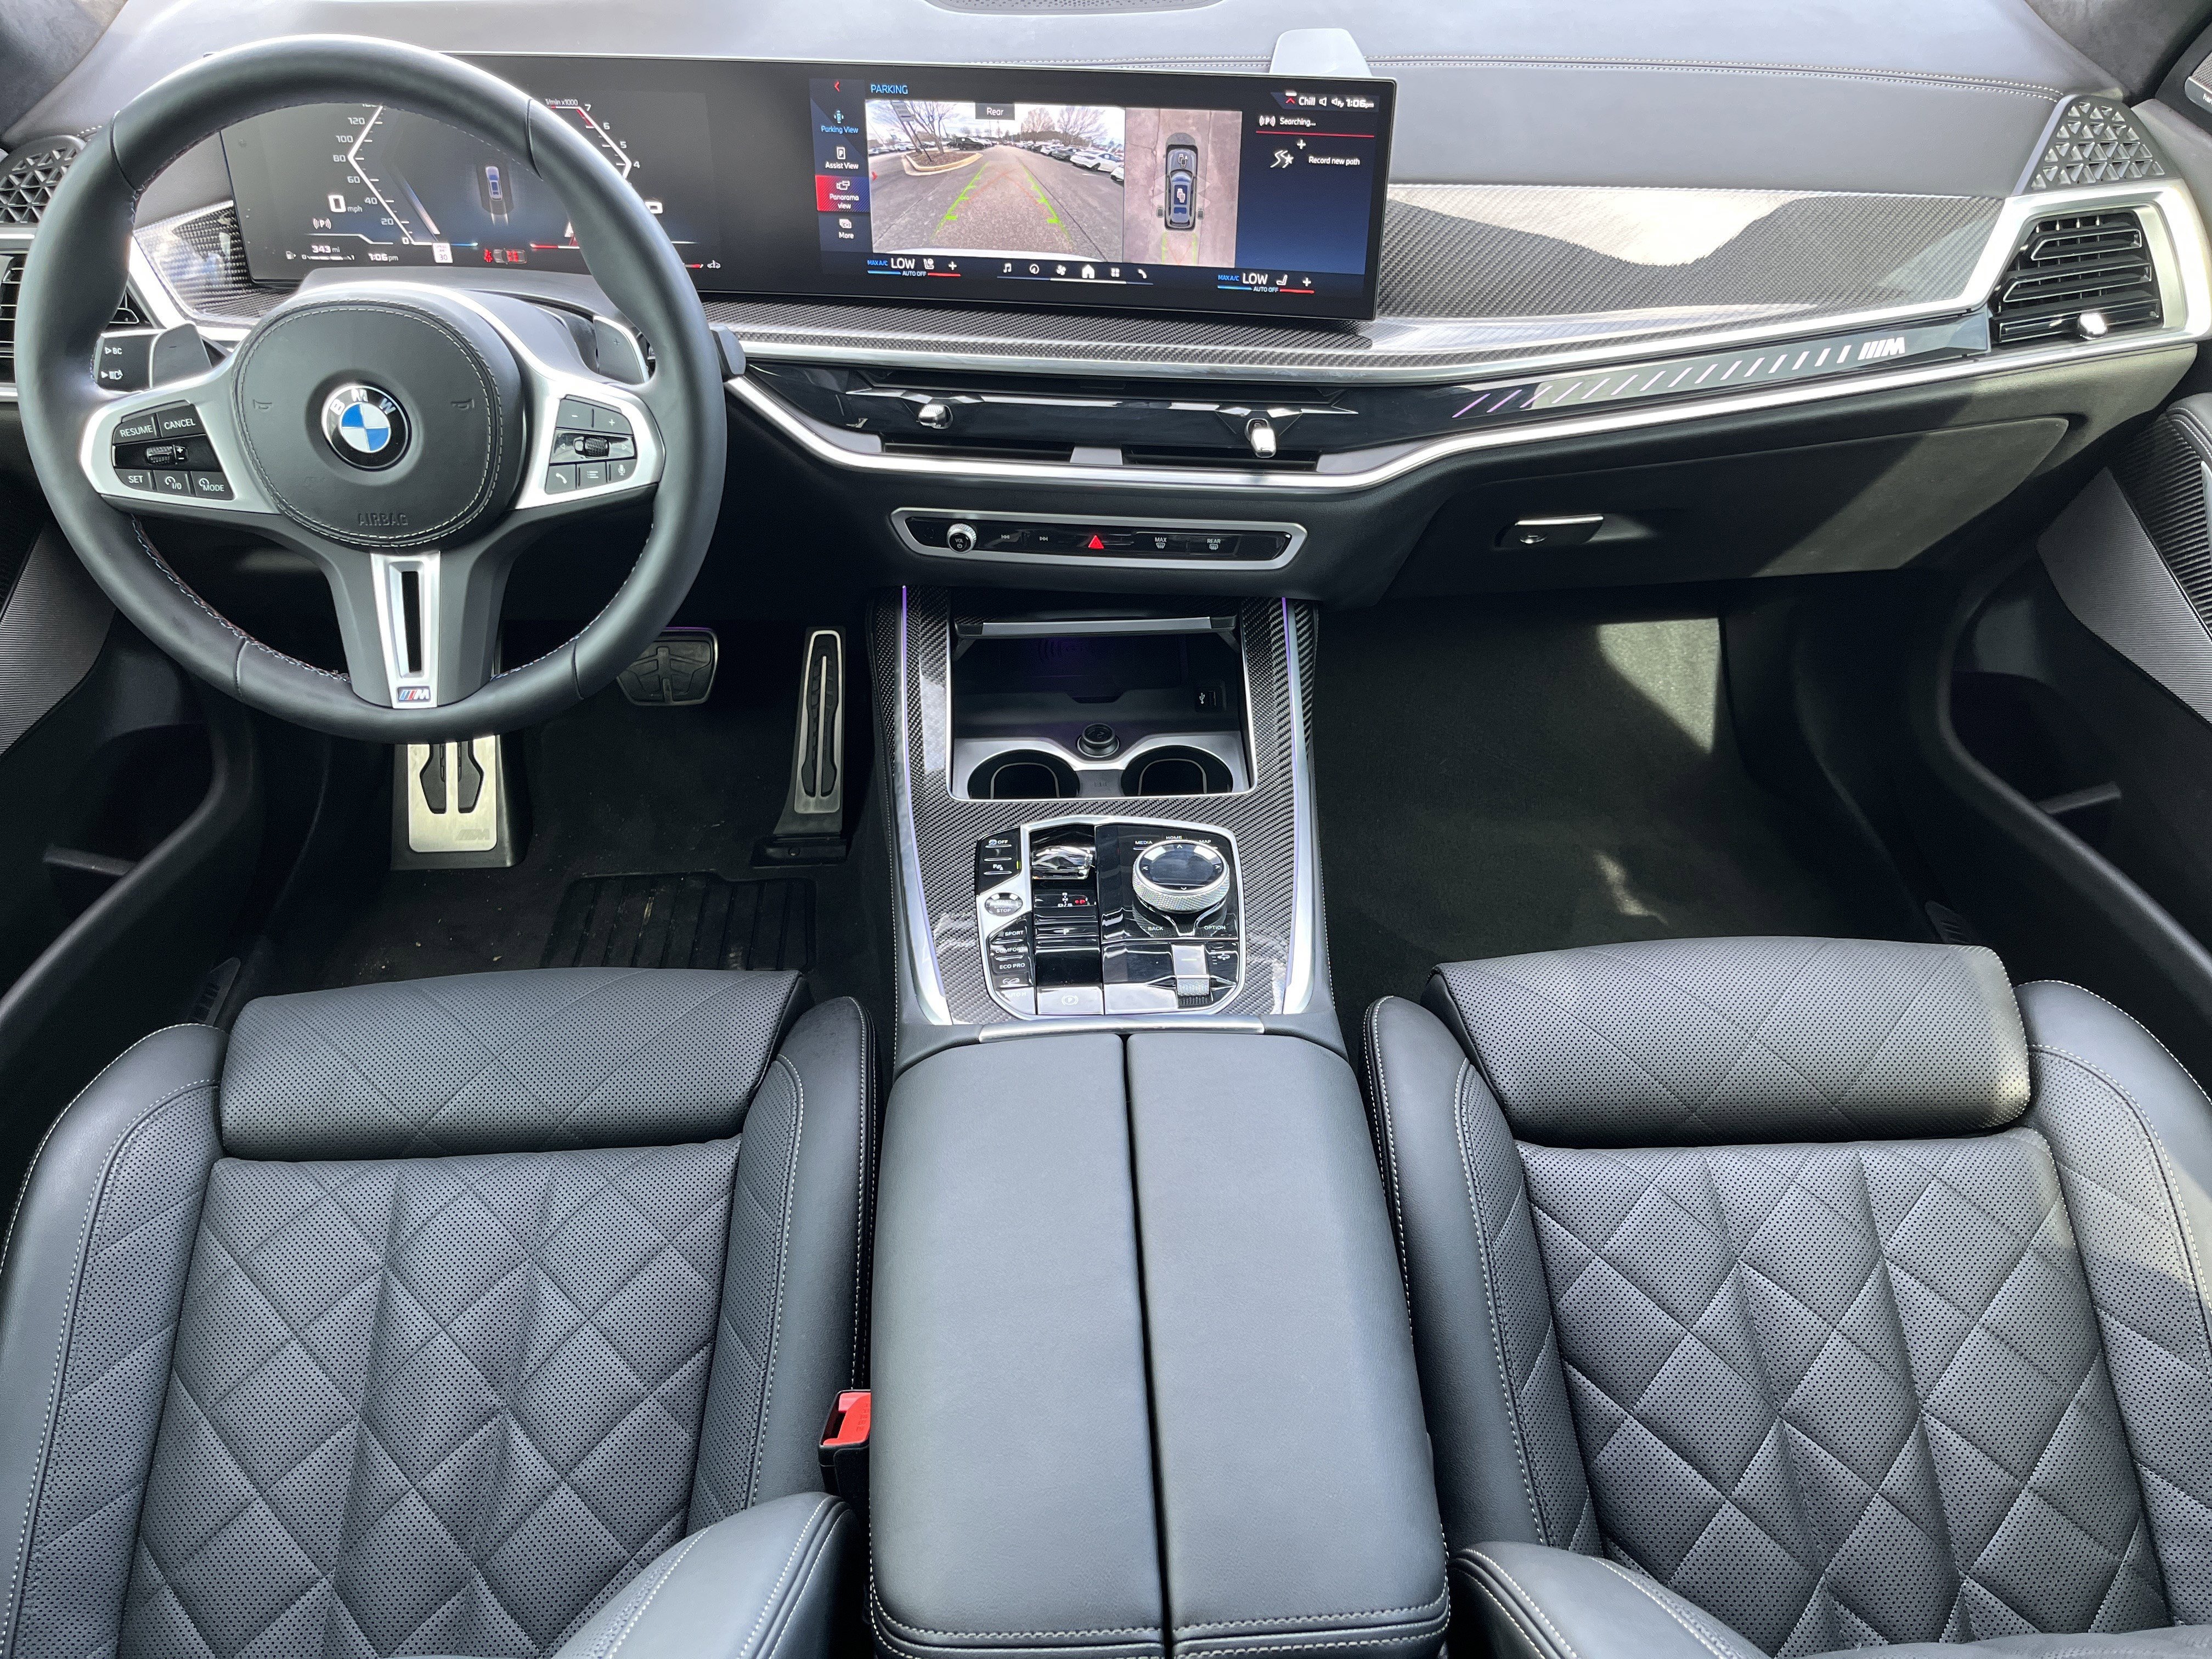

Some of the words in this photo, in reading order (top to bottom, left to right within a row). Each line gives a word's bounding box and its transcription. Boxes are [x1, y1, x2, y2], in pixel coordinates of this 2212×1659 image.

[870, 83, 908, 94] PARKING
[1298, 96, 1316, 106] Chill
[986, 107, 1004, 116] Rear
[347, 117, 365, 125] 120
[603, 122, 611, 130] 6
[821, 125, 843, 134] Parking
[619, 140, 627, 149] 5
[1308, 155, 1331, 165] Record
[1346, 157, 1361, 166] path
[825, 161, 844, 170] Assist
[347, 176, 360, 184] 60
[364, 196, 378, 205] 40
[829, 193, 859, 201] Panorama
[328, 194, 347, 213] 0
[347, 205, 363, 214] mph
[402, 236, 410, 245] 0
[311, 245, 331, 253] 343
[890, 257, 916, 269] LOW
[1243, 272, 1268, 285] LOW
[329, 388, 397, 416] BMW
[164, 417, 196, 430] CANCEL
[120, 425, 154, 437] RESUME
[128, 475, 144, 483] SET
[358, 512, 409, 527] AIRBAG
